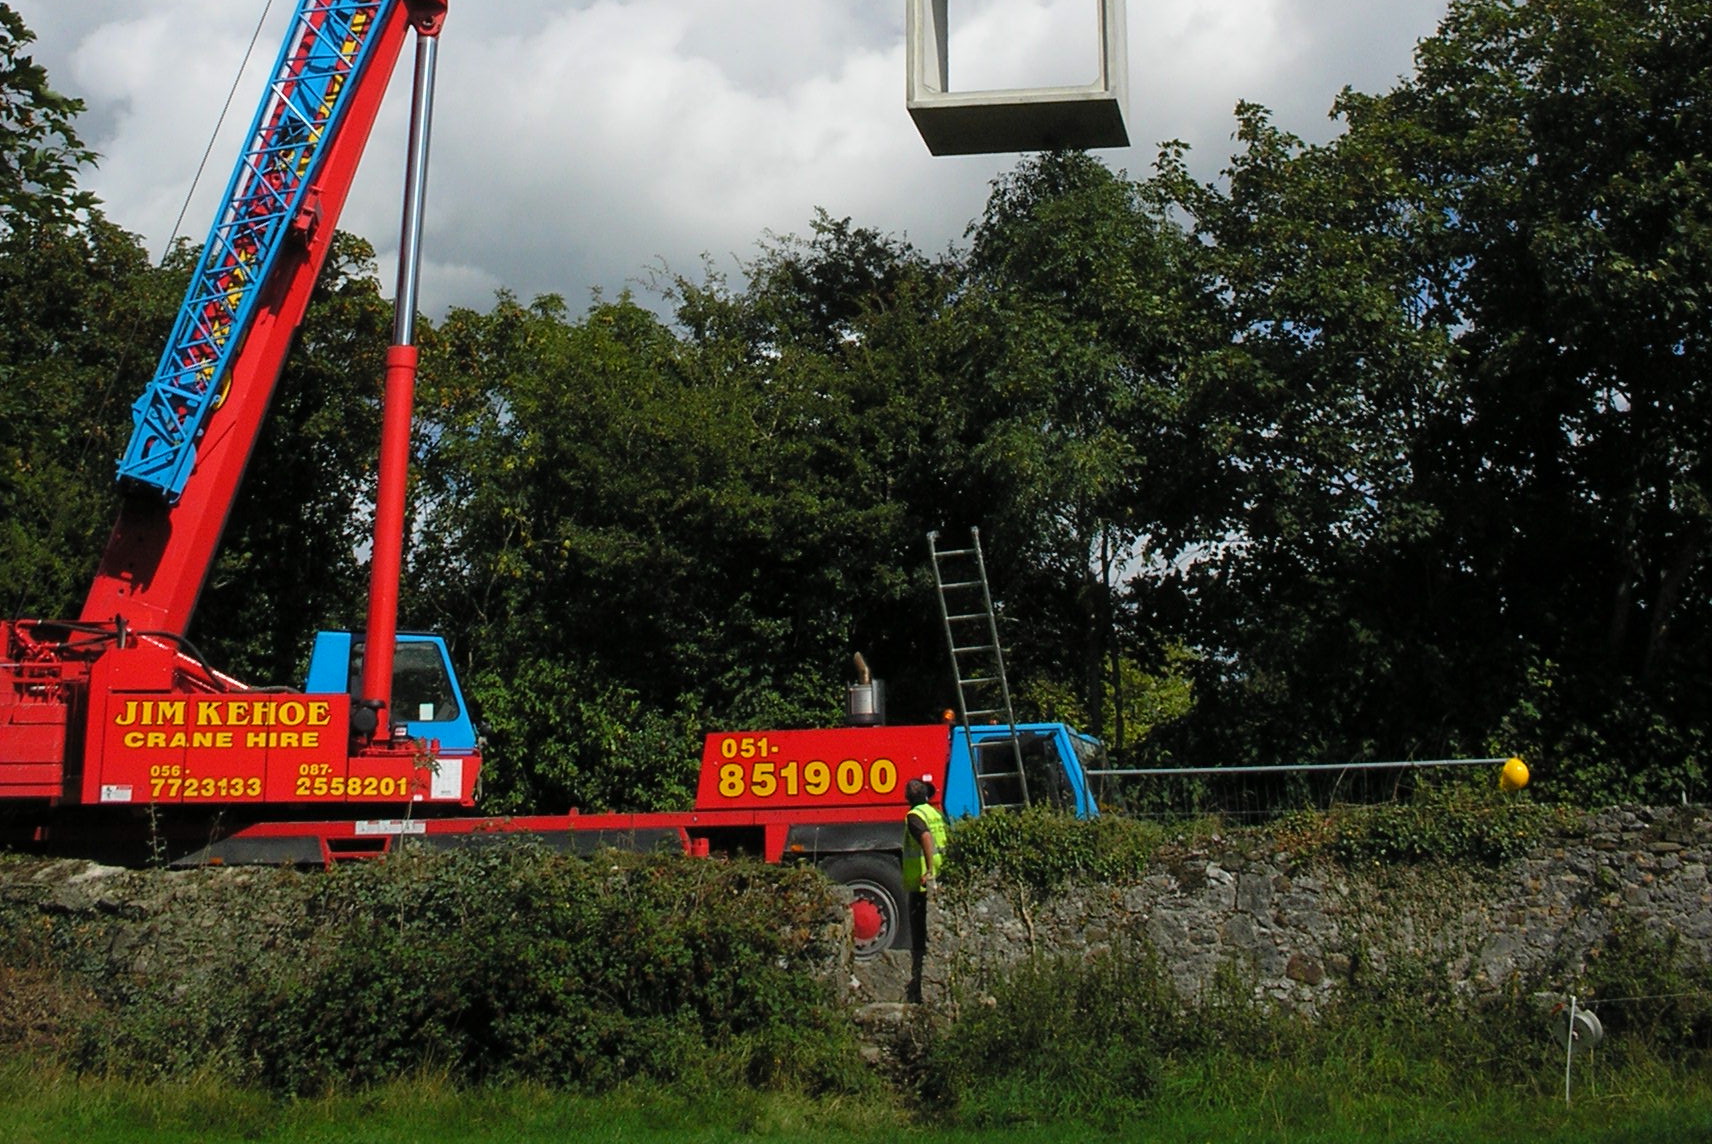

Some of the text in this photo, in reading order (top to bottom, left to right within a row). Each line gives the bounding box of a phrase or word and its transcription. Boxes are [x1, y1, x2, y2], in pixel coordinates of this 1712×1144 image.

[114, 700, 332, 727] JIM KEHOE
[123, 730, 320, 749] CRANE HIRE
[720, 736, 780, 759] 051-
[298, 762, 333, 776] 087-
[717, 758, 898, 799] 851900
[149, 777, 262, 797] 7723133
[295, 776, 408, 797] 2558201
